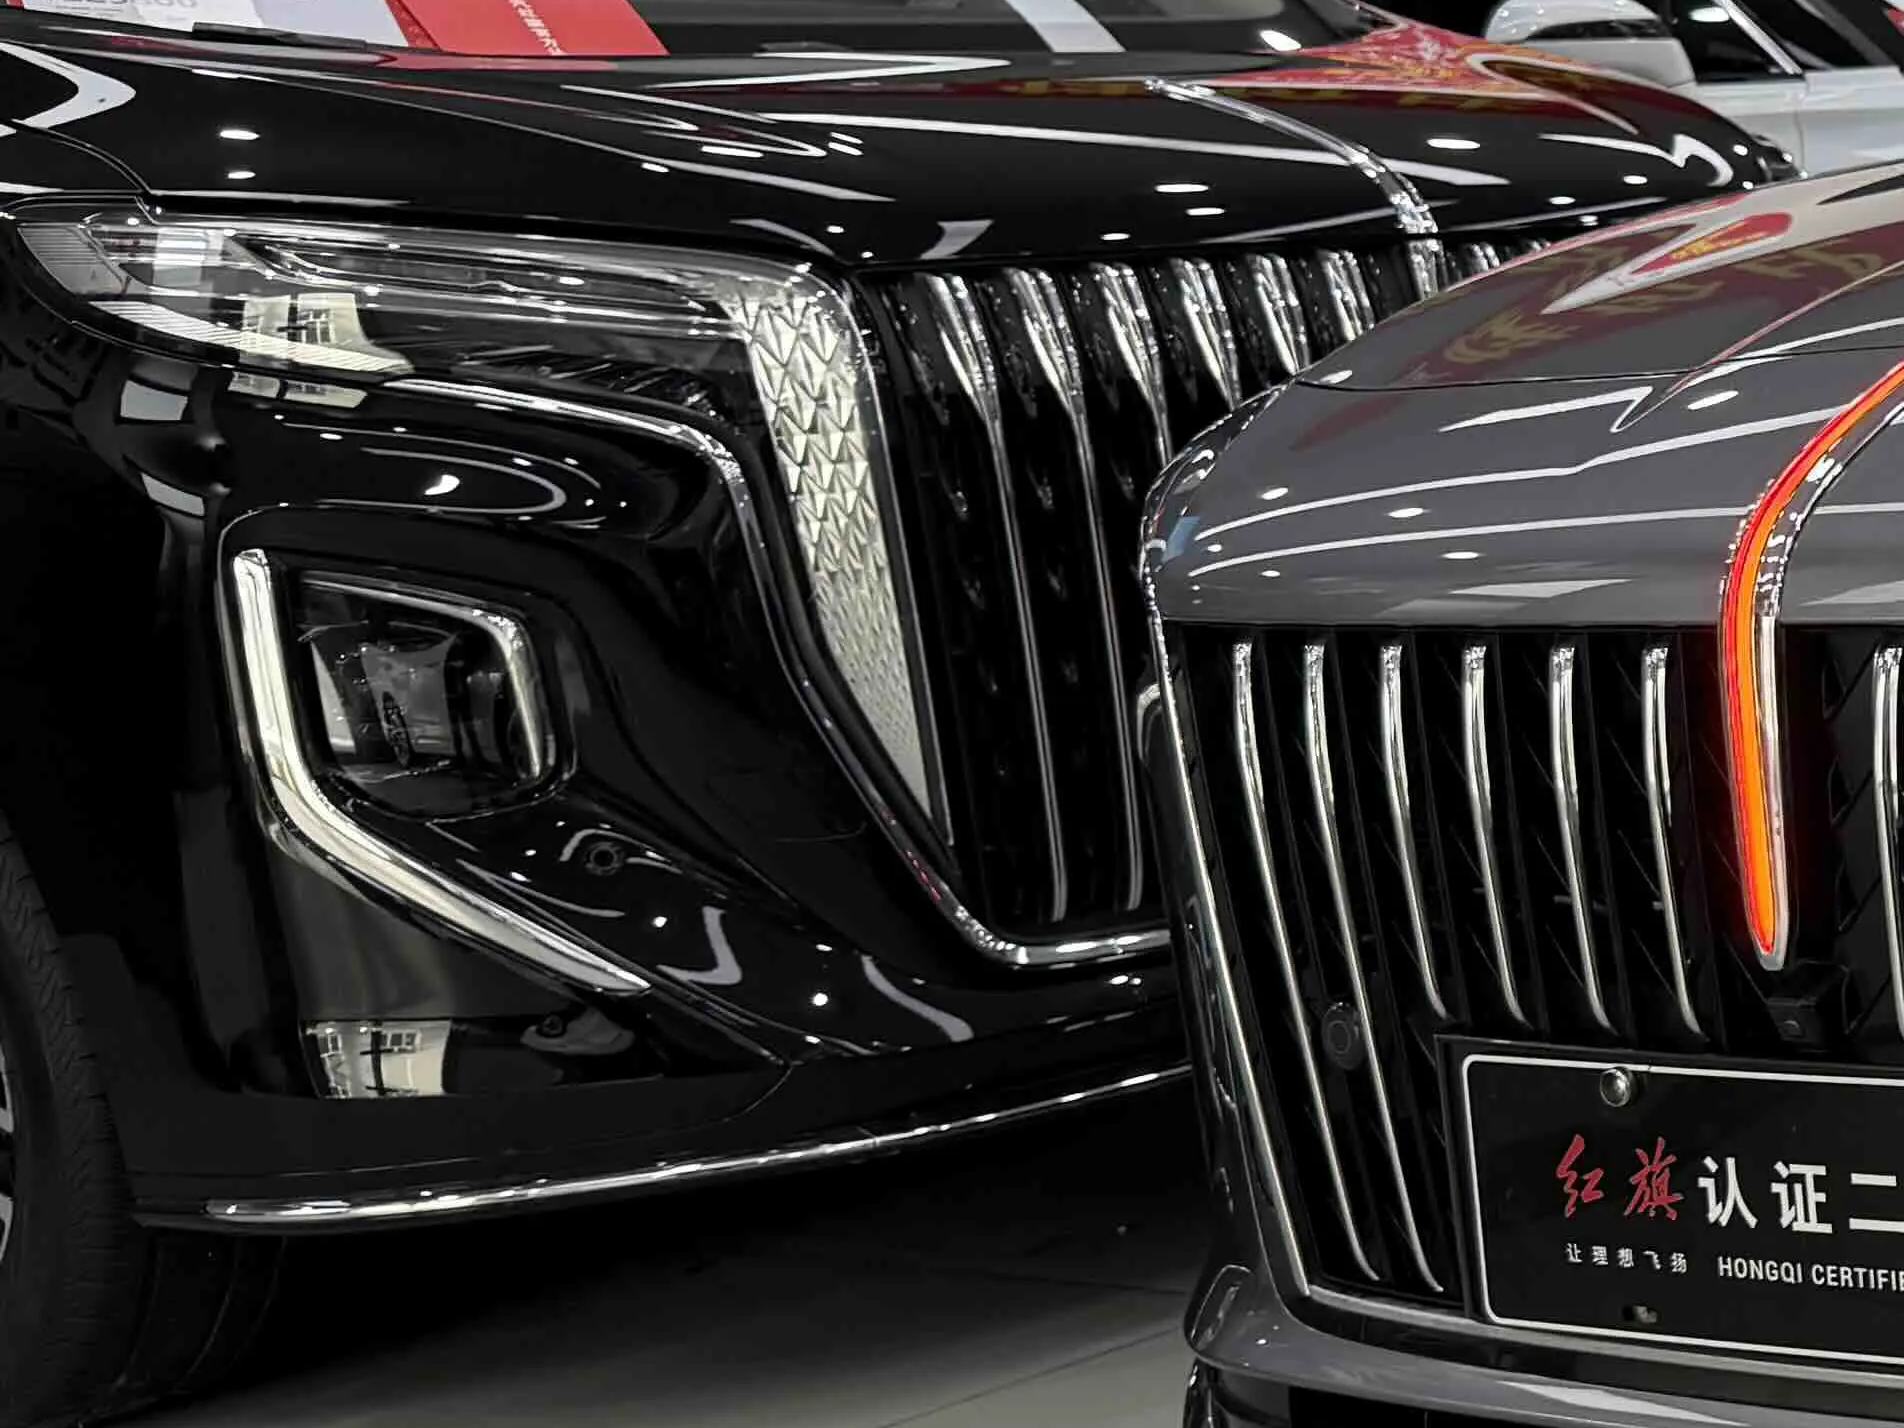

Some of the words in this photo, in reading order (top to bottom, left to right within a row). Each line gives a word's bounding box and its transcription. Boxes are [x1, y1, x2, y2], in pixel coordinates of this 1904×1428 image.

[1566, 1243, 1687, 1273] 让理想飞扬
[1718, 1256, 1802, 1284] HONGQI
